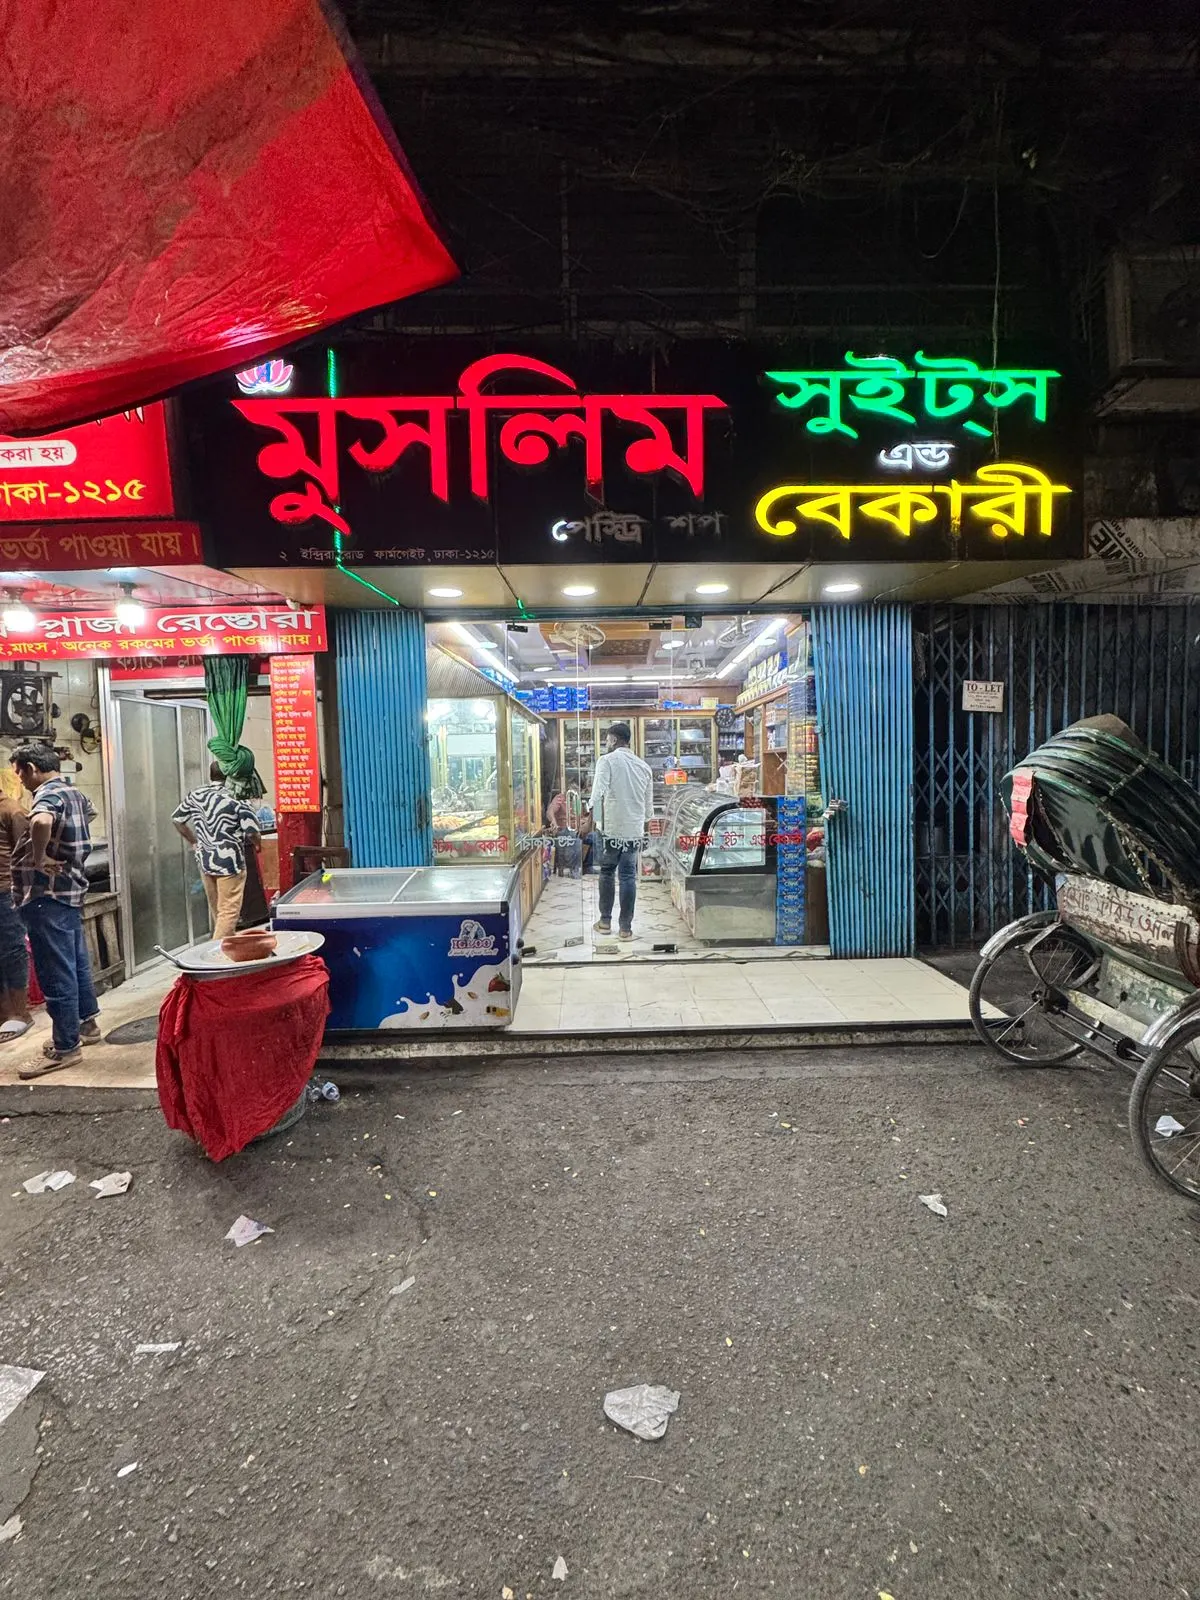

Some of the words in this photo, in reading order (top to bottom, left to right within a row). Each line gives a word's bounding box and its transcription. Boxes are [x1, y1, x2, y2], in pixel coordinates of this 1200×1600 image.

[39, 446, 66, 463] হয়
[231, 353, 727, 535] মুসলিম
[879, 441, 955, 469] এন্ড
[0, 480, 147, 506] াকা-১২১৫
[755, 464, 1073, 539] বেকারী
[59, 531, 132, 561] পাওয়া
[136, 530, 182, 557] যায়
[60, 639, 112, 652] অনেক
[118, 636, 175, 651] রকমের
[180, 634, 217, 648] ভর্তা
